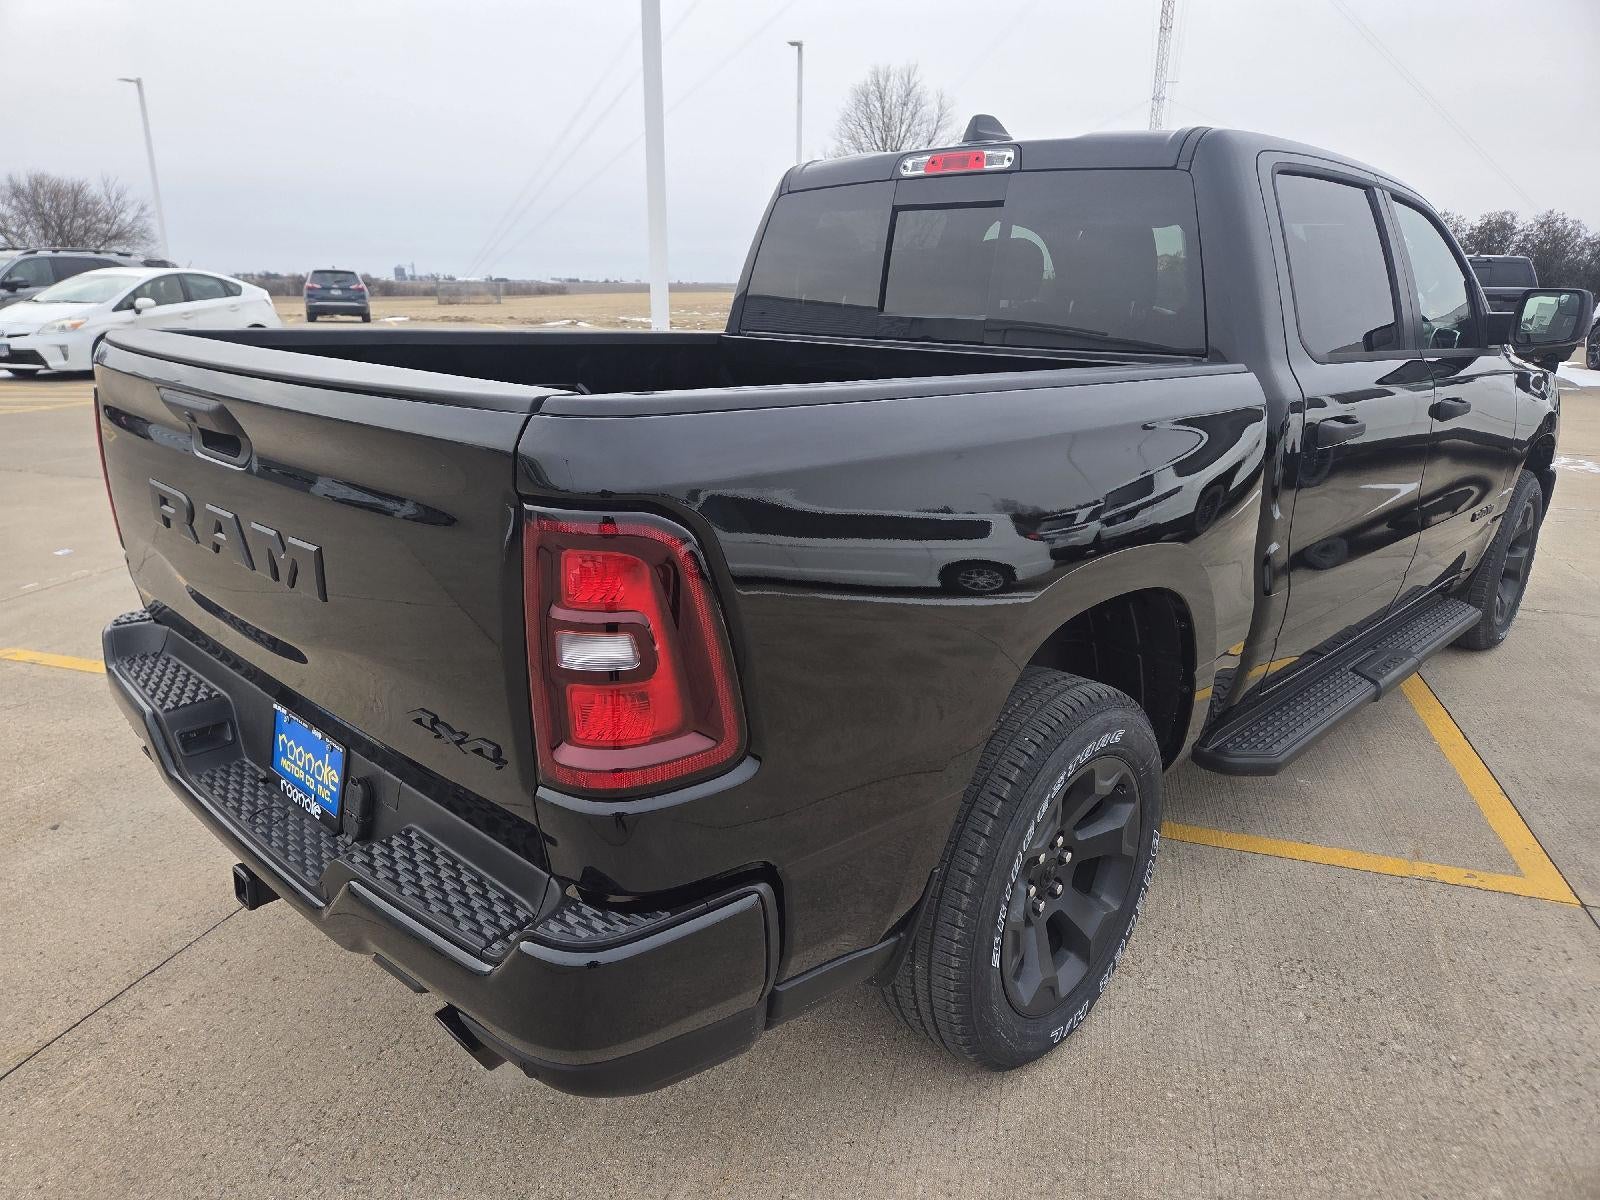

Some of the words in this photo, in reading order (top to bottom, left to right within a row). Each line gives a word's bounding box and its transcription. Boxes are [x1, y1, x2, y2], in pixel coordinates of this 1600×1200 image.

[149, 477, 329, 603] RAM
[280, 757, 304, 782] MOTOR
[305, 774, 316, 791] CO.
[317, 784, 332, 803] INC.
[991, 729, 1126, 969] BRIDGESTONE
